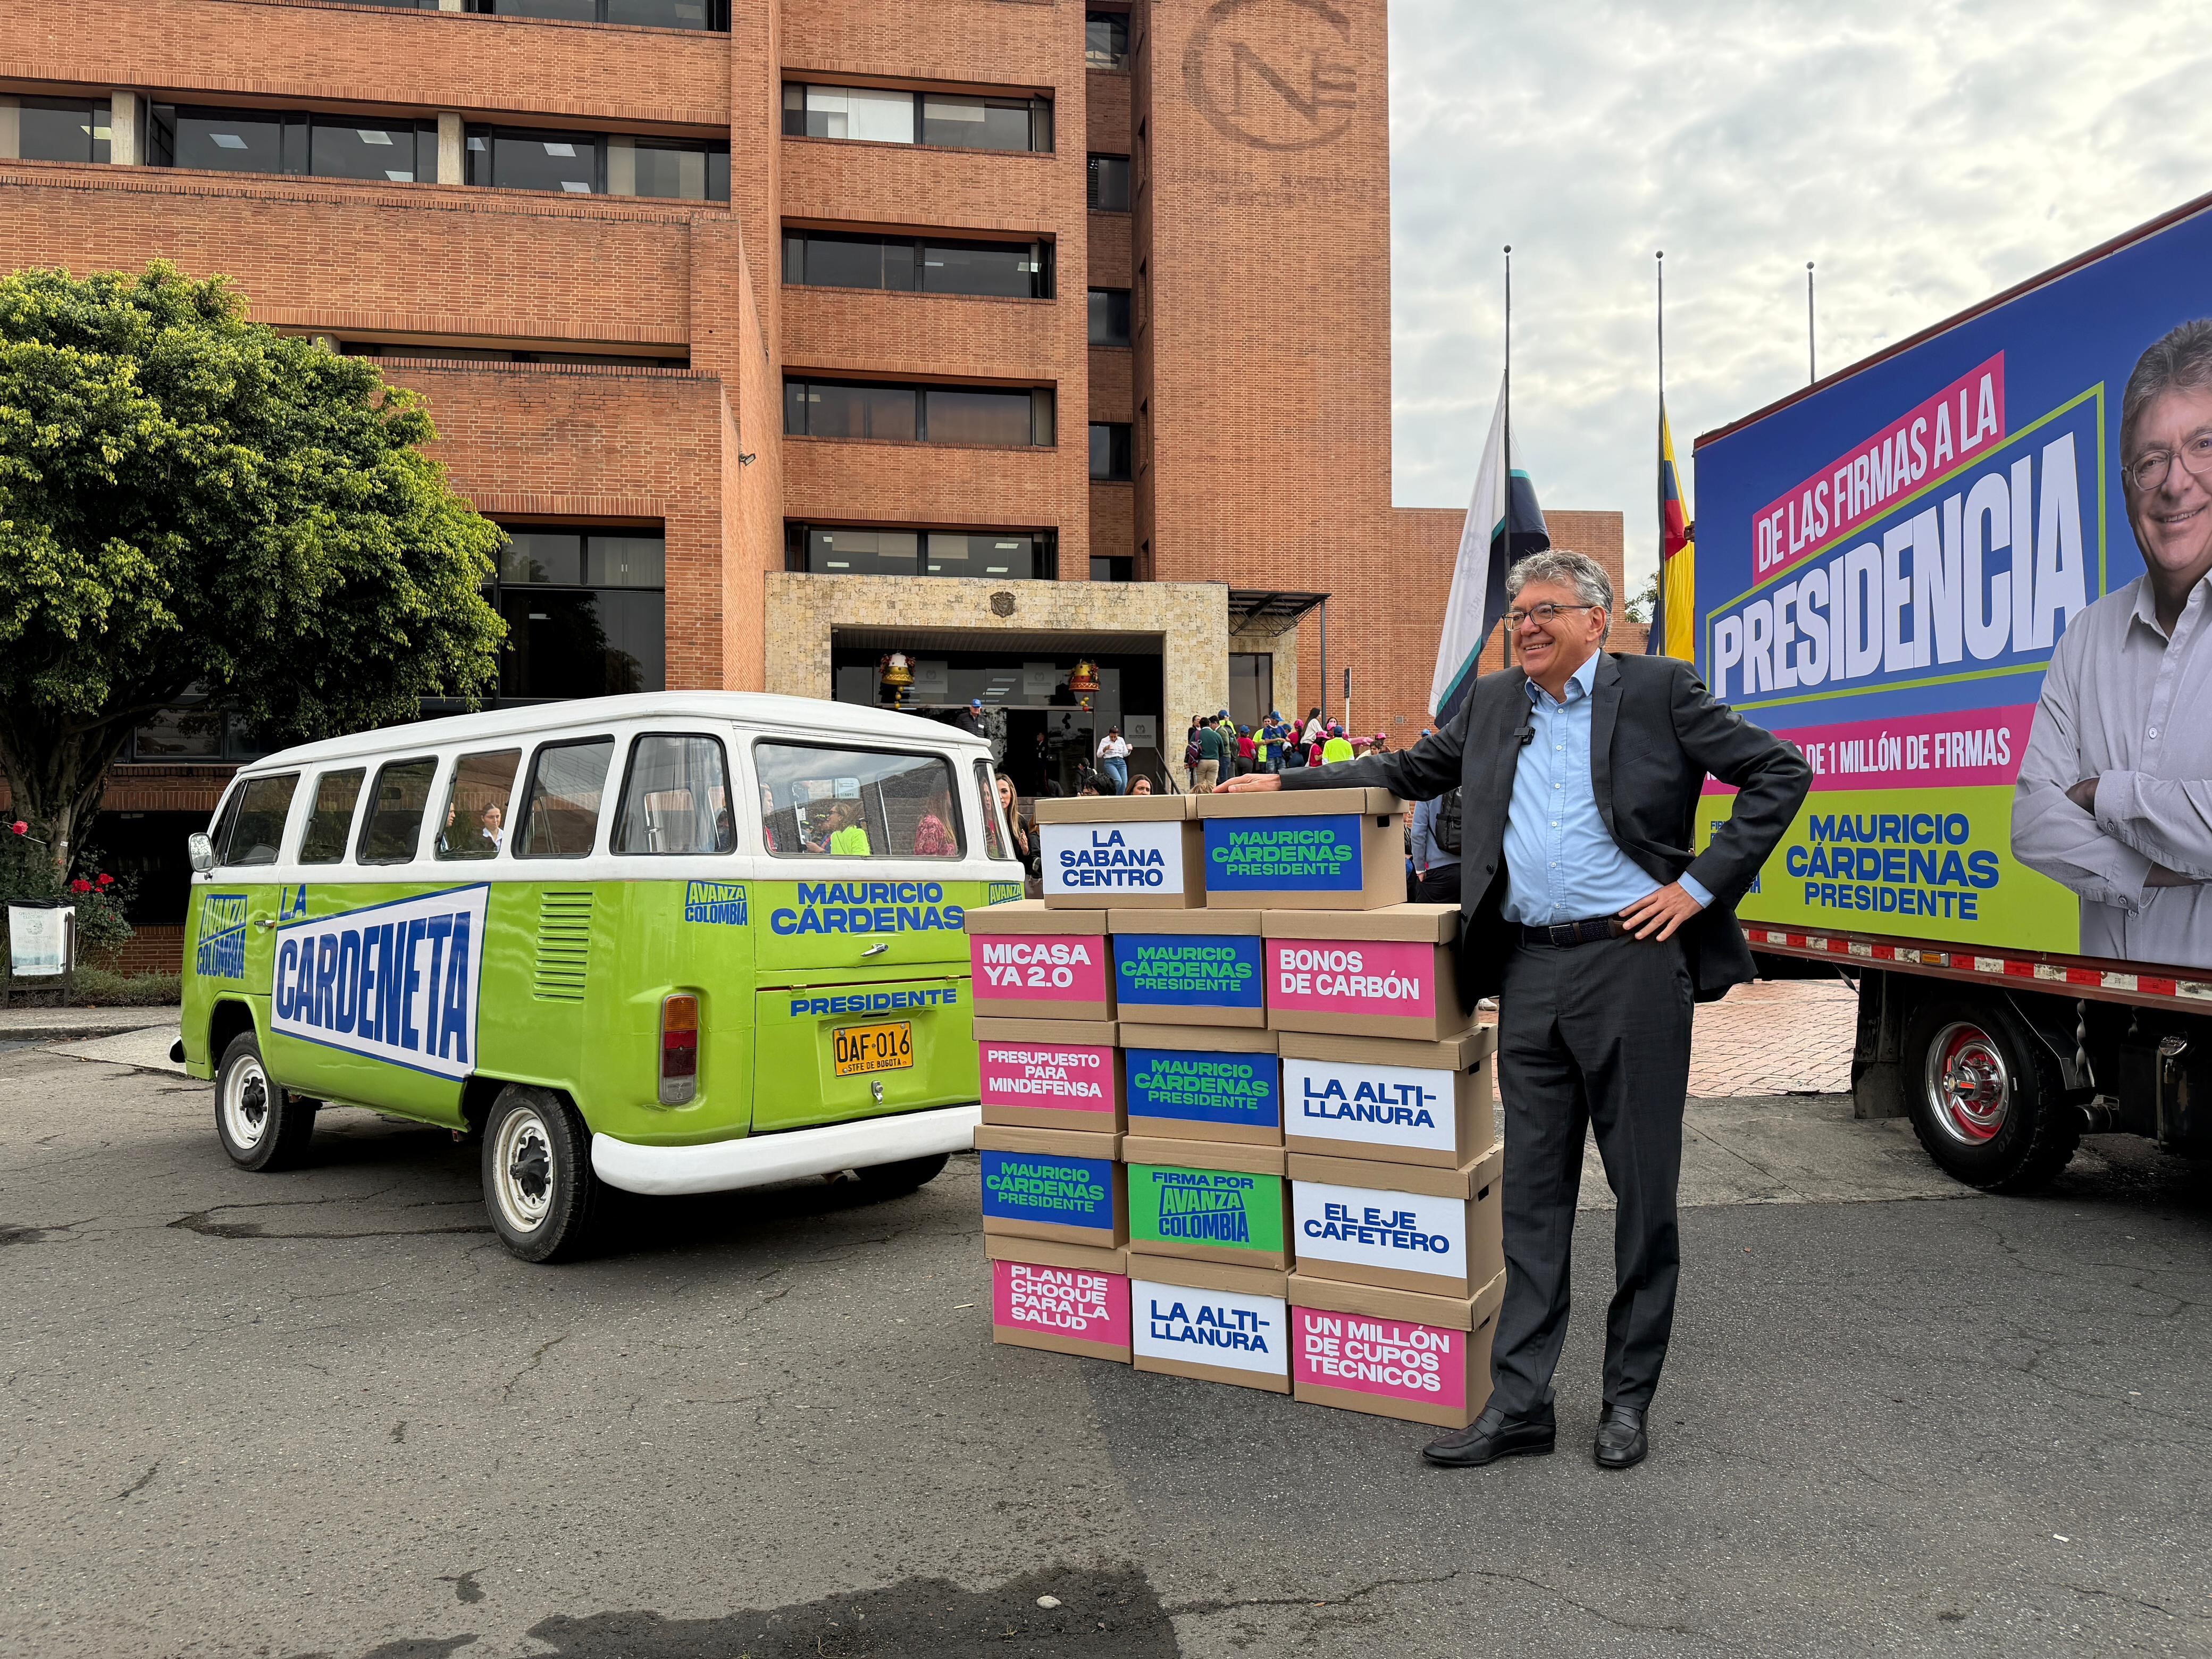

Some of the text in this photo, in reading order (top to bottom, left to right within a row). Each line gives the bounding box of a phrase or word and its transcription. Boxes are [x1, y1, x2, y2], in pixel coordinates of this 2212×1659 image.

[1759, 373, 1997, 572] DE LAS FIRMAS A LA
[1715, 432, 2090, 699] PRESIDENCIA
[1807, 727, 2010, 774] DE 1 MILLÓN DE FIRMAS
[1093, 831, 1125, 847] LA
[1230, 830, 1335, 847] MAURICIO
[1810, 814, 1969, 845] MAURICIO
[1060, 849, 1164, 867] SABANA
[1212, 844, 1352, 863] CÁRDENAS
[1787, 842, 1999, 889] CÁRDENAS
[1063, 869, 1163, 886] CENTRO
[1227, 863, 1340, 875] PRESIDENTE
[279, 884, 306, 921] LA
[689, 883, 744, 904] AVANZA
[798, 883, 942, 904] MAURICIO
[991, 885, 1020, 903] AVANZA
[1805, 882, 1978, 920] PRESIDENTE
[201, 898, 246, 941] AVANZA
[685, 902, 747, 926] COLOMBIA
[771, 904, 964, 935] CÁRDENAS
[197, 929, 246, 979] COLOMBIA
[983, 944, 1091, 965] MICASA
[1138, 947, 1235, 960] MAURICIO
[1280, 950, 1362, 973] BONOS
[983, 966, 1073, 987] YA 2.0
[1121, 959, 1252, 978] CÁRDENAS
[276, 911, 471, 1063] CARDENETA
[1135, 978, 1241, 991] PRESIDENTE
[1281, 970, 1419, 999] DE CARBÓN
[791, 988, 956, 1016] PRESIDENTE
[877, 1029, 909, 1057] 016
[877, 1059, 901, 1068] BOGOTA
[988, 1050, 1100, 1067] PRESUPUESTO
[1152, 1060, 1252, 1078] MAURICIO
[1025, 1066, 1067, 1079] PARA
[1135, 1071, 1269, 1096] CÁRDENAS
[990, 1077, 1102, 1097] MINDEFENSA
[1304, 1077, 1436, 1107] LA ALTI-
[1149, 1091, 1258, 1109] PRESIDENTE
[1304, 1100, 1435, 1128] LLANURA
[1002, 1162, 1089, 1182] MAURICIO
[1152, 1172, 1253, 1189] FIRMA POR
[987, 1175, 1104, 1200] CÁRDENAS
[999, 1192, 1094, 1212] PRESIDENTE
[1162, 1188, 1241, 1214] AVANZA
[1159, 1211, 1250, 1243] COLOMBIA
[1325, 1203, 1416, 1230] EL EJE
[1304, 1220, 1449, 1253] CAFETERO
[1011, 1266, 1107, 1291] PLAN DE
[1011, 1279, 1105, 1305] CHOQUE
[1012, 1293, 1110, 1320] PARA LA
[1012, 1308, 1087, 1329] SALUD
[1151, 1300, 1269, 1332] LA ALTI-
[1151, 1322, 1268, 1353] LLANURA
[1305, 1315, 1449, 1353] UN MILLÓN
[1306, 1335, 1439, 1371] DE CUPOS
[1305, 1350, 1440, 1391] TÉCNICOS
